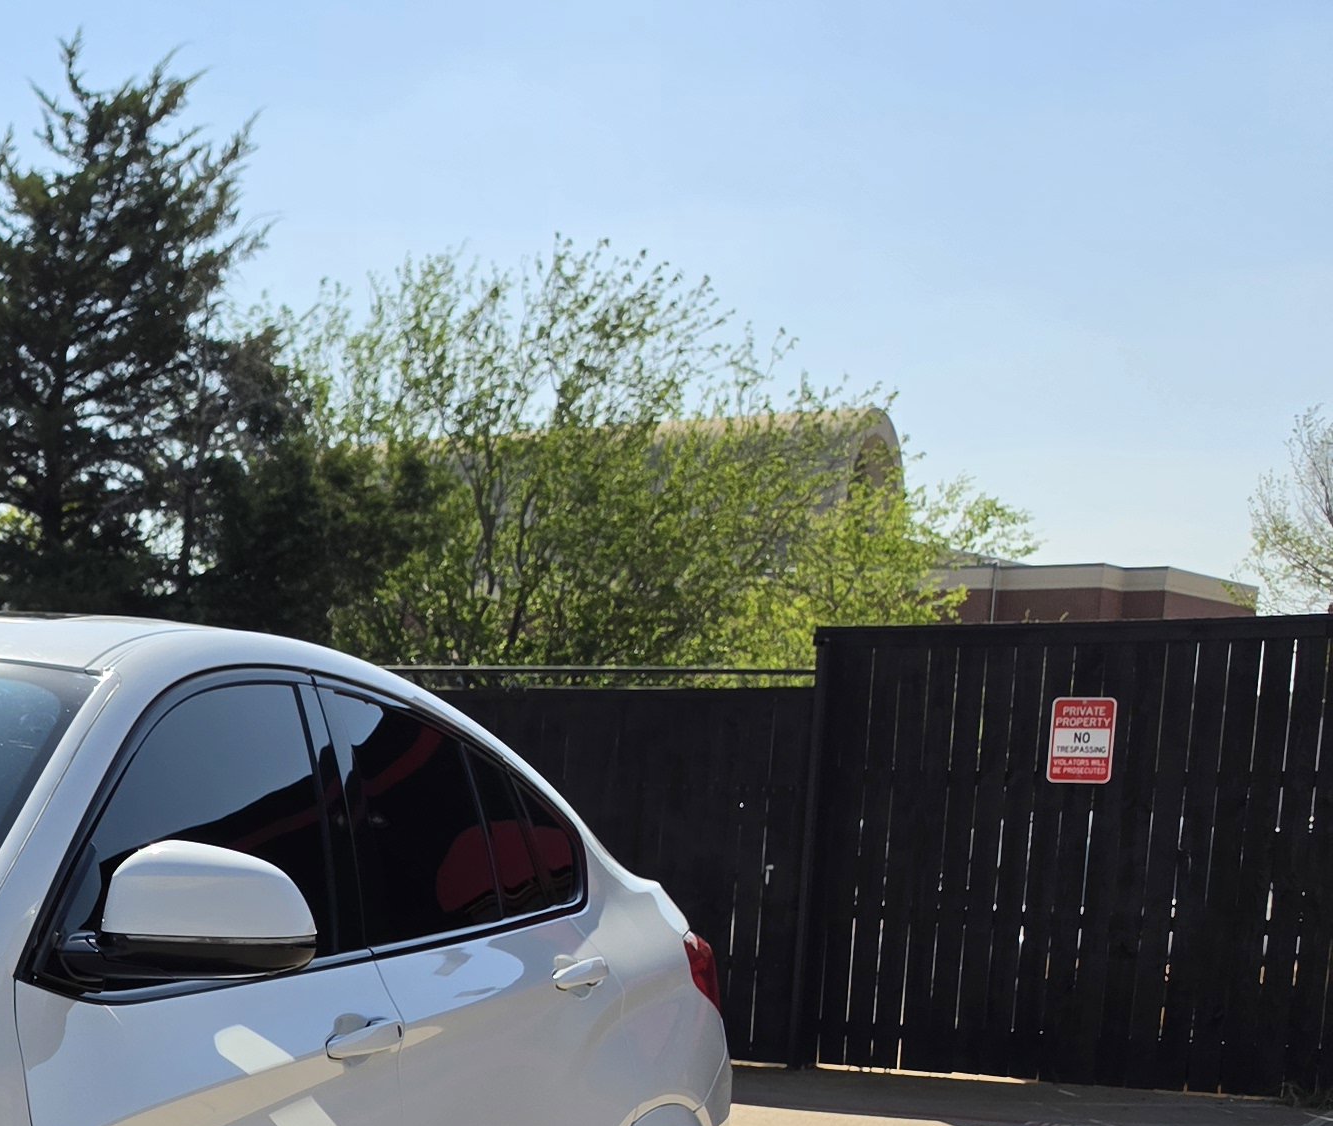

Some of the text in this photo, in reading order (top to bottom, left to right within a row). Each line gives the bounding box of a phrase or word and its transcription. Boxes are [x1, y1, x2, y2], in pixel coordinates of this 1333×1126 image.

[1062, 706, 1107, 716] PRIVATE
[1055, 717, 1112, 727] PROPERTY
[1073, 732, 1091, 744] NO
[1056, 745, 1107, 754] TRESPASSING
[1053, 758, 1090, 766] VIOLATORS
[1062, 767, 1107, 775] PROSECUTED
